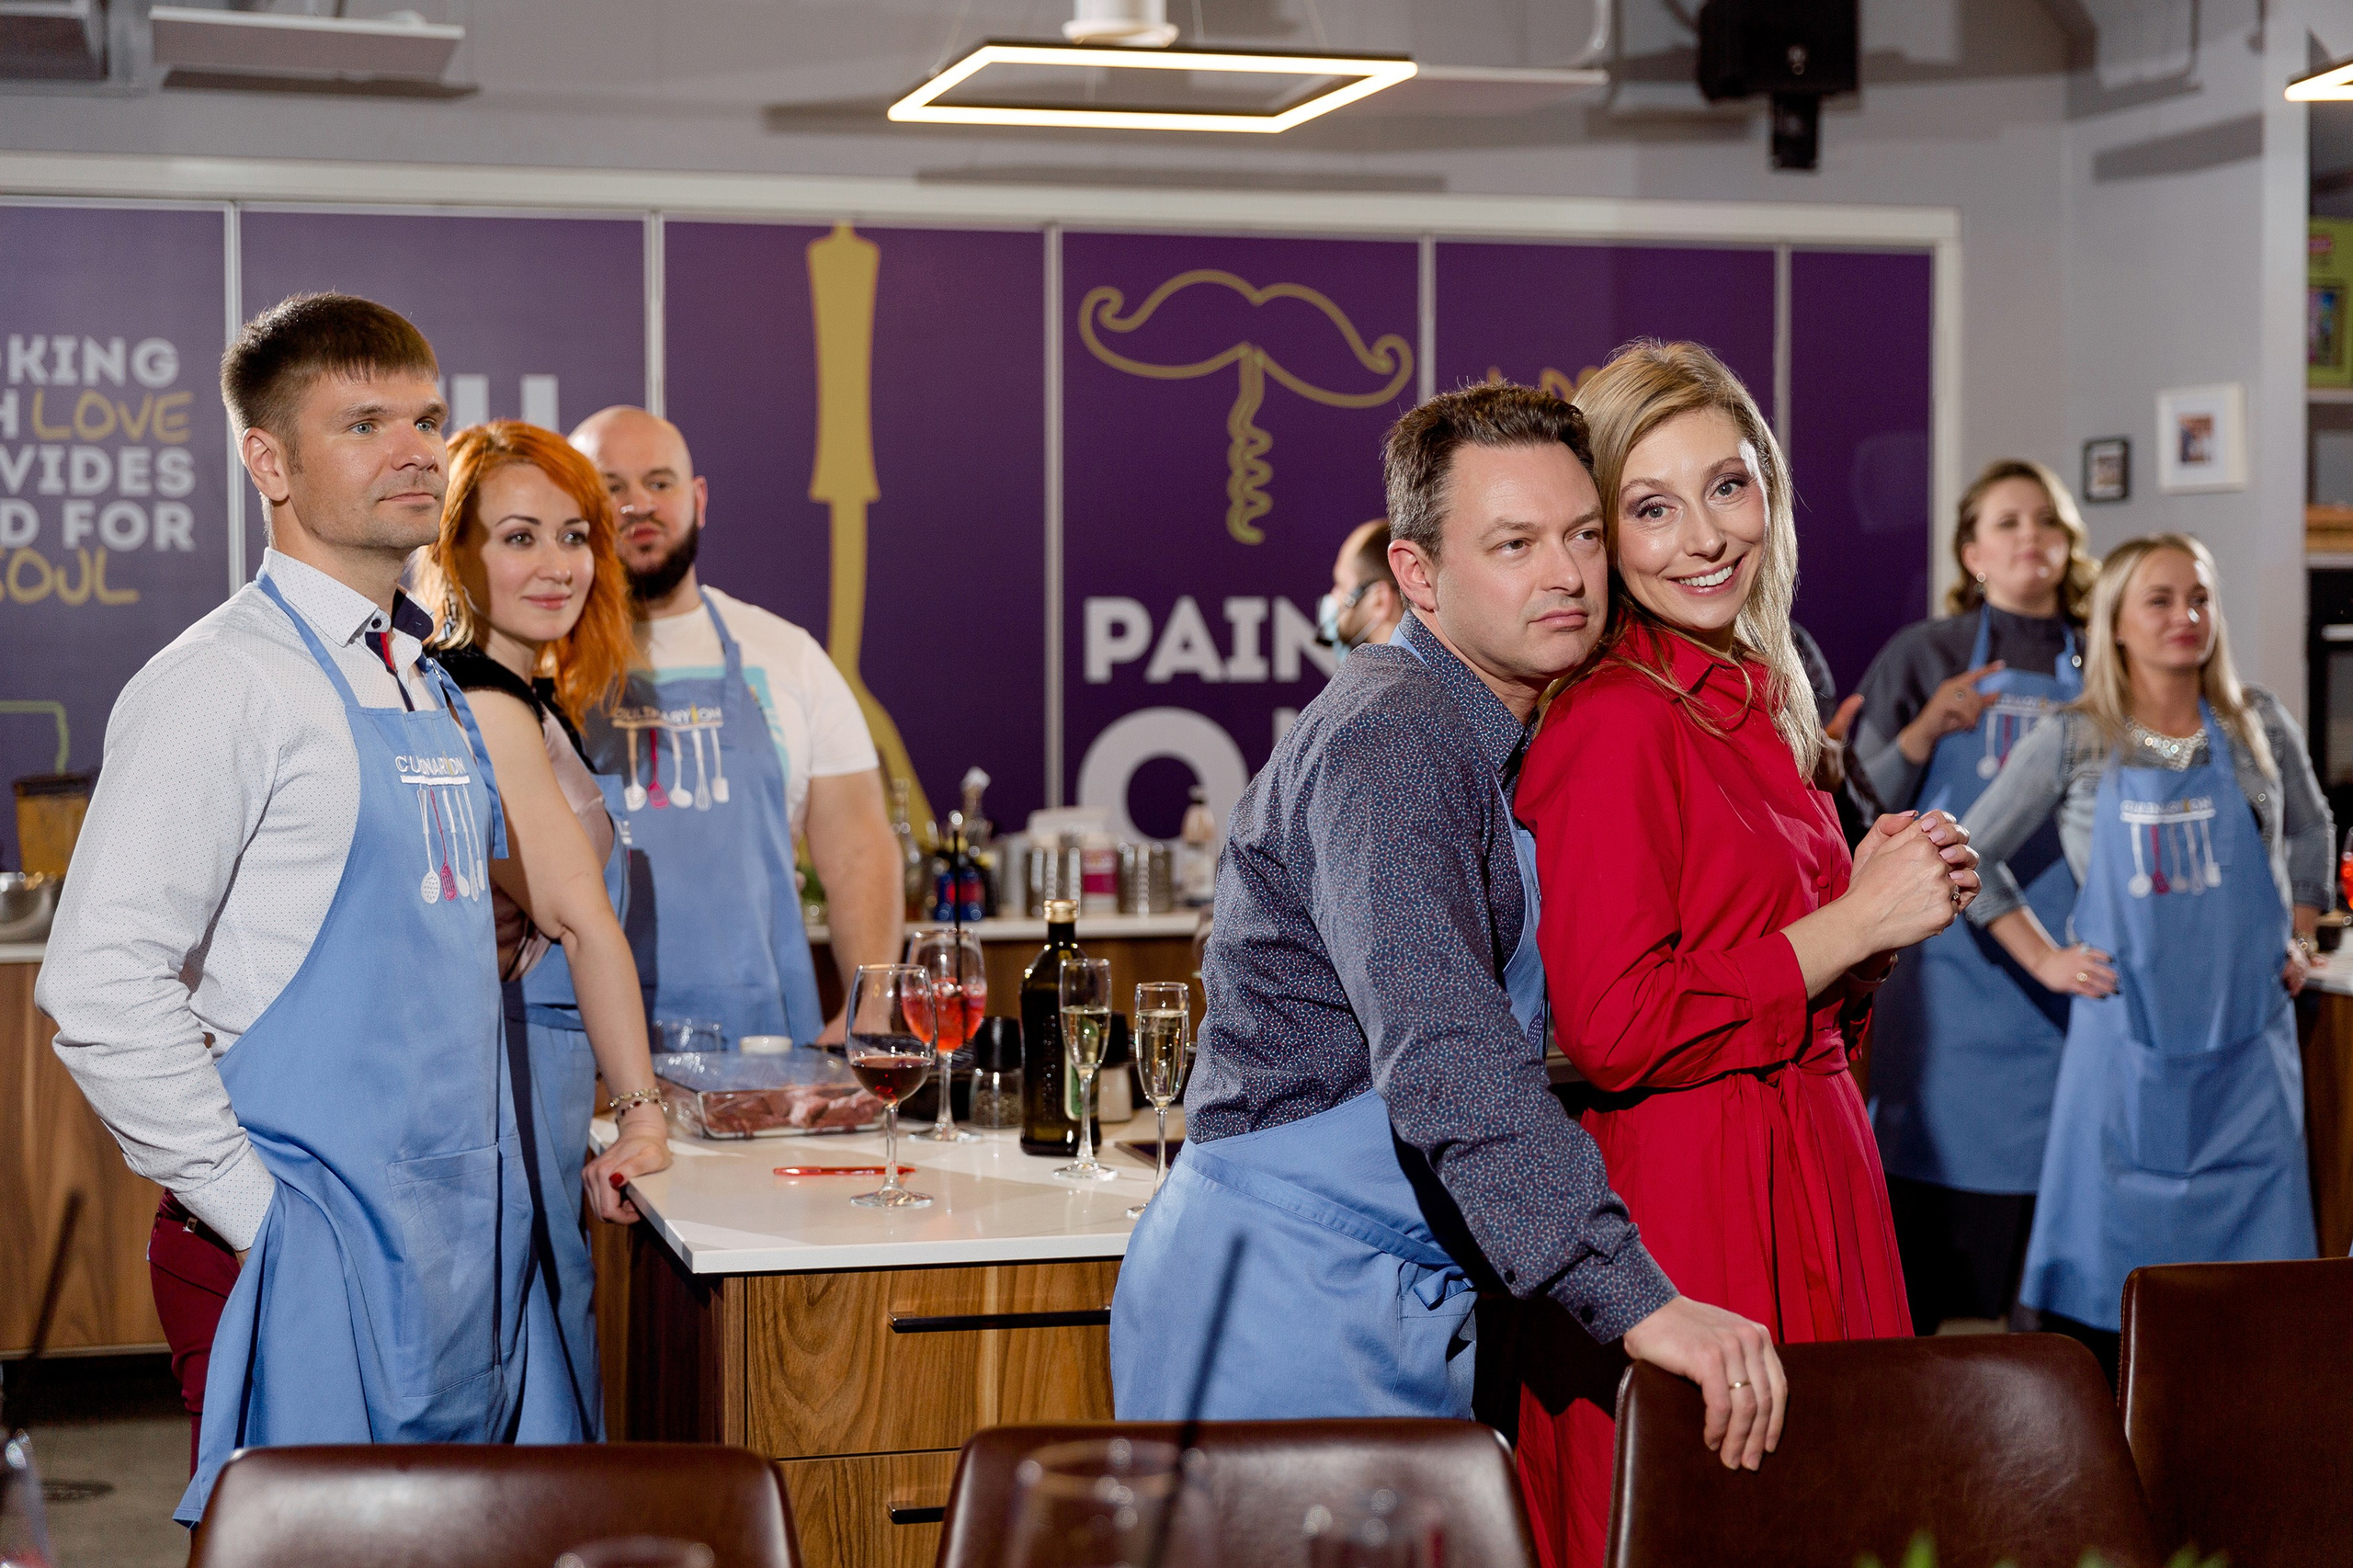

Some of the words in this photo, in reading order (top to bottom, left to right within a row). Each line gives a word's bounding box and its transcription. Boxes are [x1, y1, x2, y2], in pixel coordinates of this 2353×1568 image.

[0, 334, 180, 389] KING
[31, 388, 193, 444] LOVE
[62, 499, 196, 551] FOR
[0, 546, 141, 606] OUL
